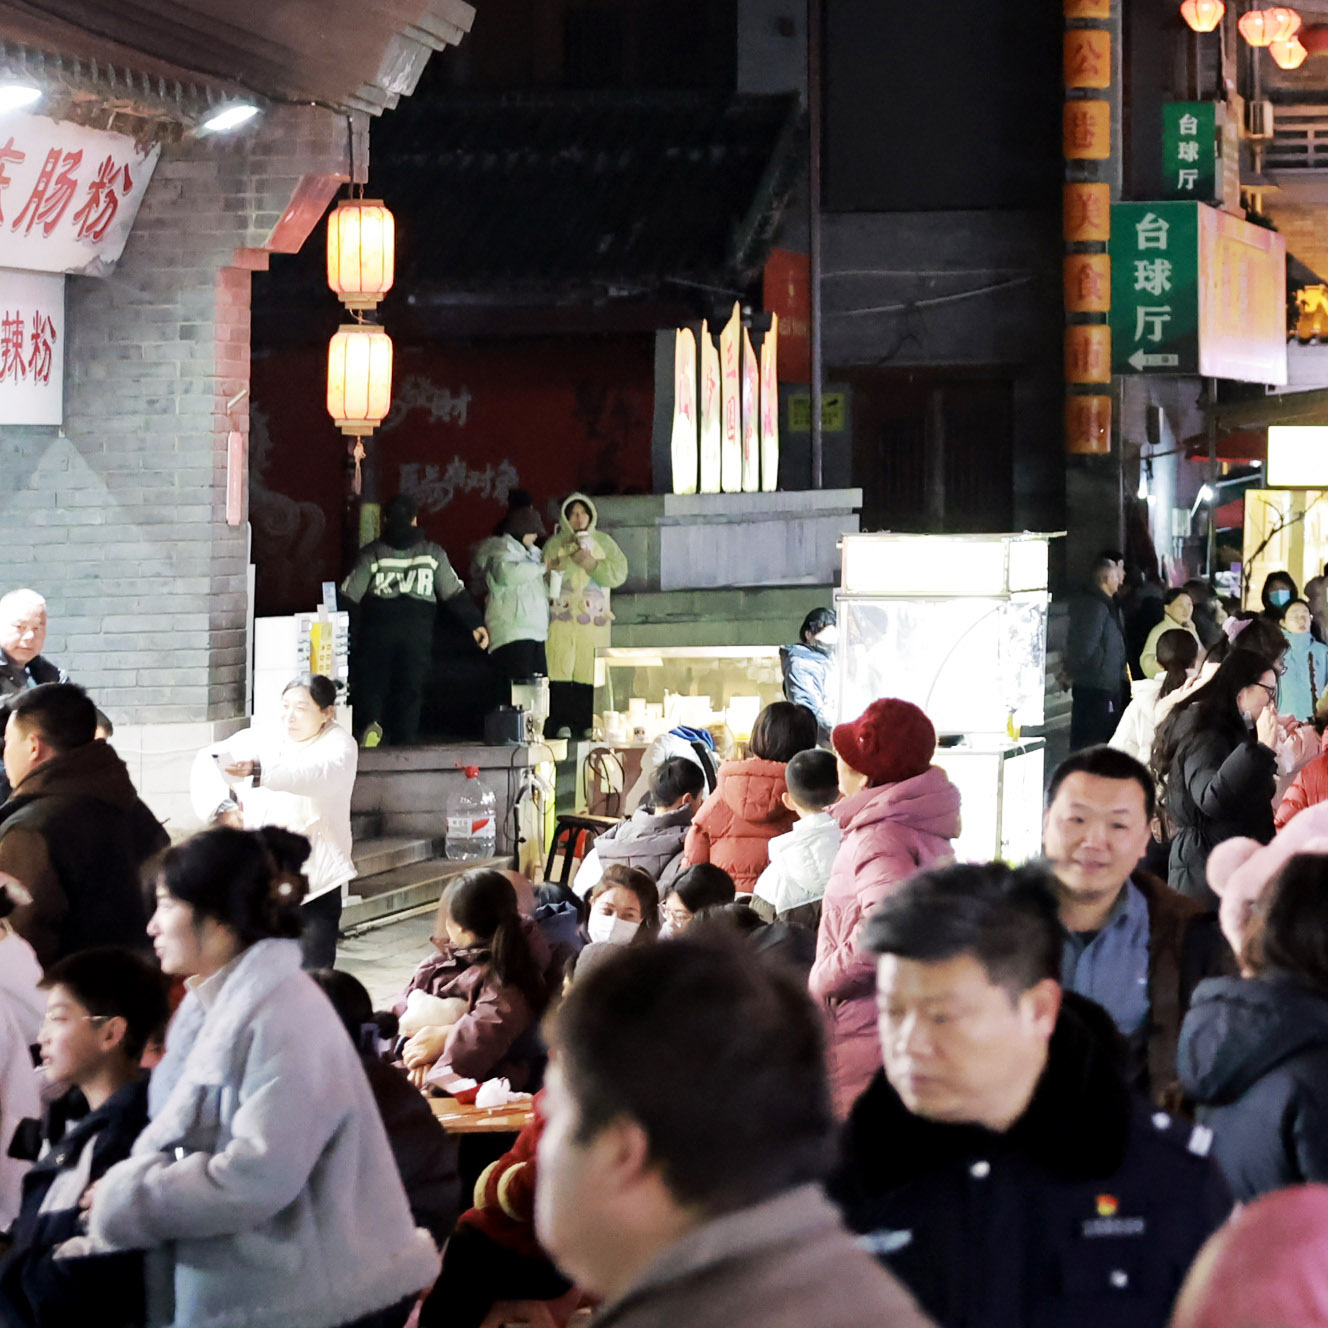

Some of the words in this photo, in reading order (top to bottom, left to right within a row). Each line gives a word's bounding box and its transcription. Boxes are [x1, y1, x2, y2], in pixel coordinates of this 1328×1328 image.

[1177, 113, 1199, 190] 台球厅
[1134, 212, 1172, 343] 台球厅
[374, 568, 434, 596] KVR
